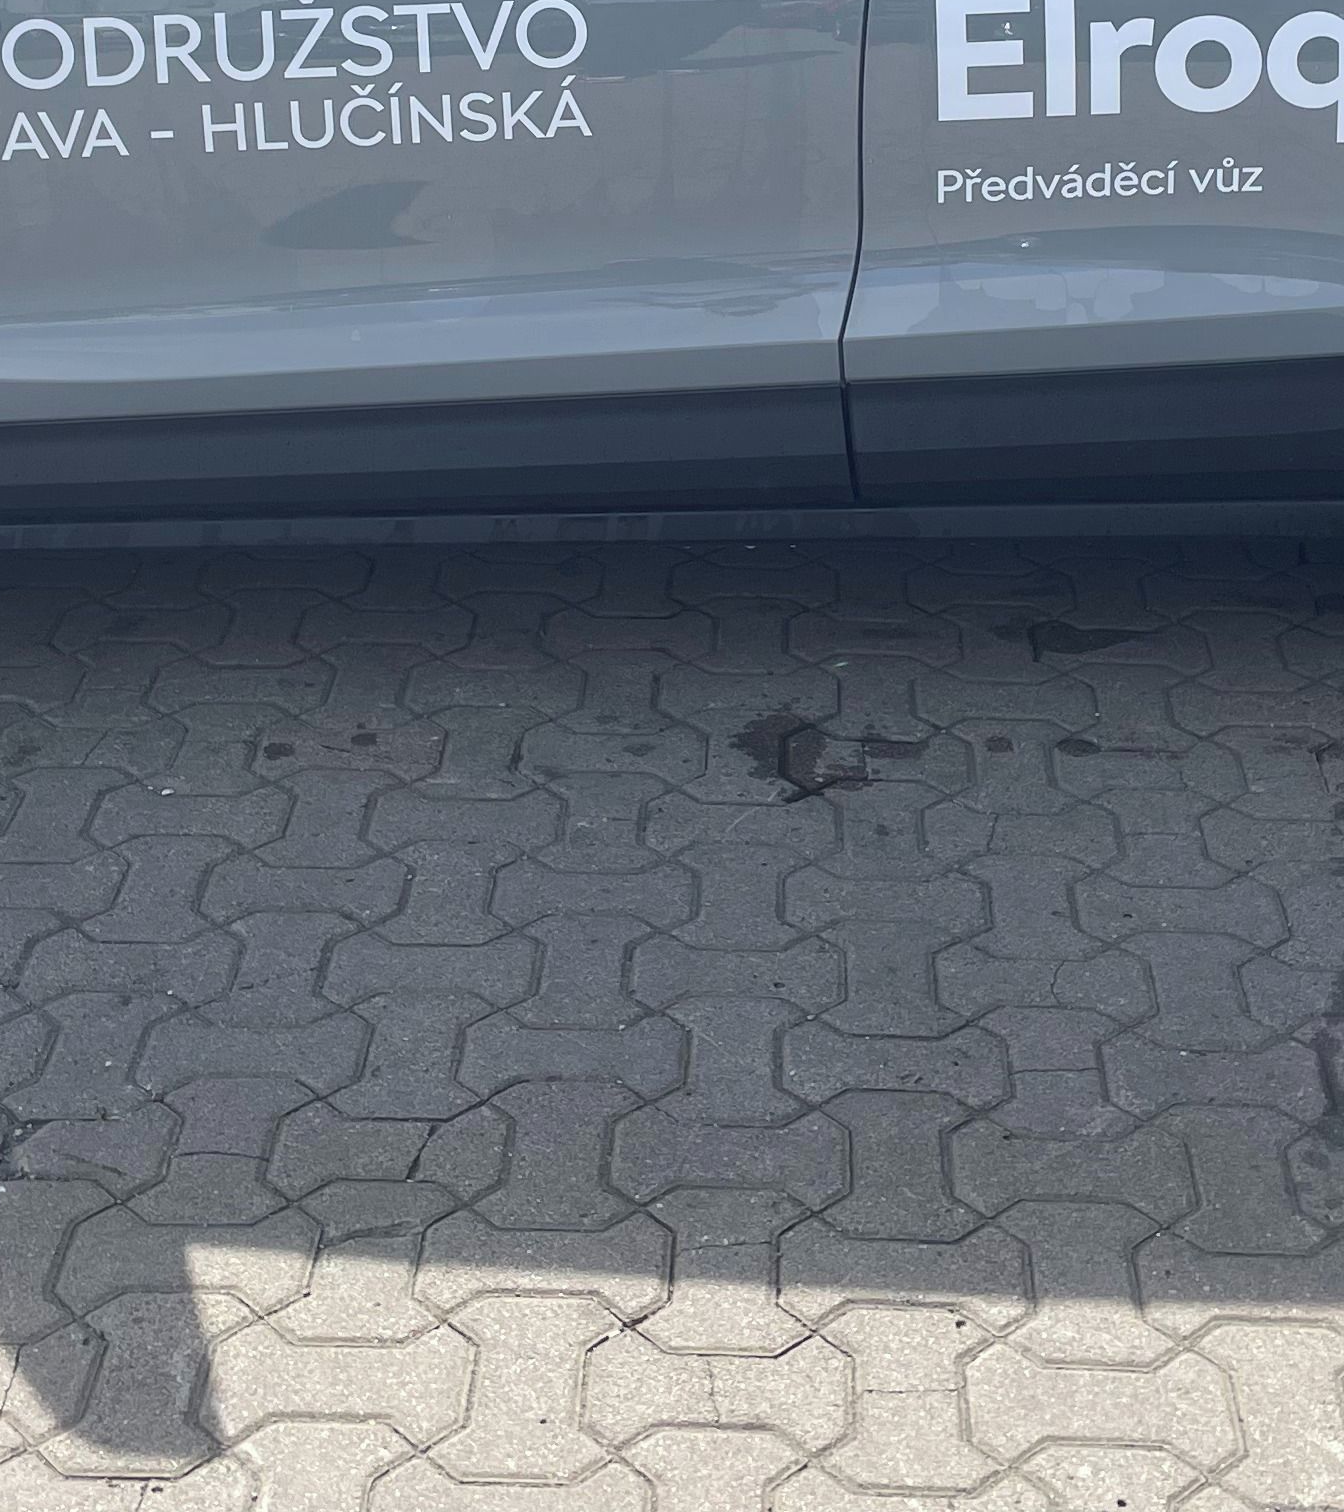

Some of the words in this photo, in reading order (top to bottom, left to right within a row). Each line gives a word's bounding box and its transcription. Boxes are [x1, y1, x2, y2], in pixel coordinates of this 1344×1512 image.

[201, 73, 593, 154] HLUČÍNSKÁ
[936, 159, 1176, 204] Předváděcí
[1188, 156, 1264, 193] vůz
